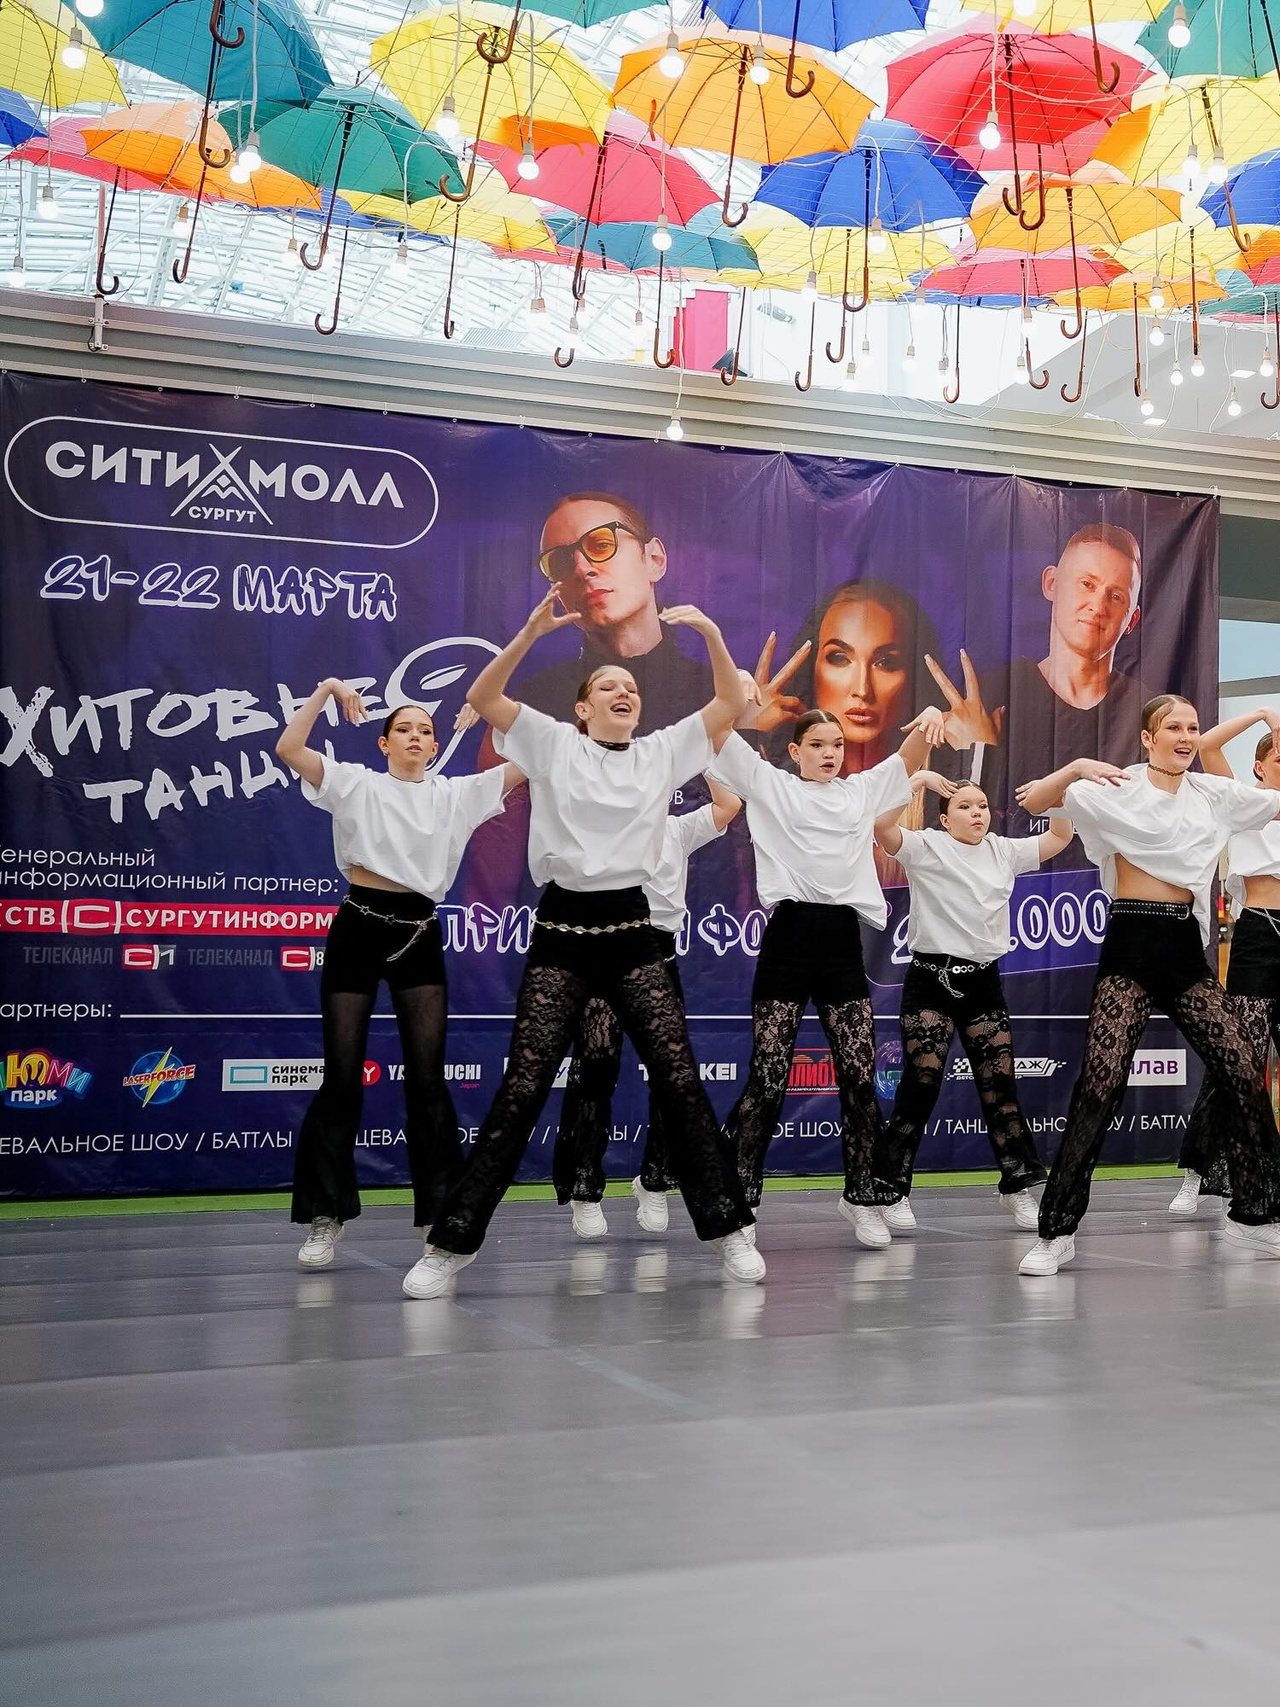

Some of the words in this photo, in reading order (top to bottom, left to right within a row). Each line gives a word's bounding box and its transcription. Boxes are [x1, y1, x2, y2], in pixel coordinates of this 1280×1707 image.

[45, 440, 201, 488] СИТИ
[248, 460, 405, 509] МОЛЛ
[188, 506, 257, 524] СУРГУТ
[40, 554, 221, 610] 21-22
[232, 563, 399, 622] МАРТА
[234, 876, 339, 895] партнер:
[5, 906, 55, 925] СТВ
[126, 908, 337, 929] СУРГУТИНФОРМ
[22, 946, 114, 966] ТЕЛЕКАНАЛ
[187, 948, 273, 967] ТЕЛЕКАНАЛ
[271, 1075, 309, 1086] парк
[388, 1064, 482, 1081] YAUCHI
[10, 1089, 57, 1105] парк
[131, 1133, 189, 1151] ШОУ
[212, 1131, 292, 1150] БАТТЛЫ
[1141, 1114, 1191, 1130] БАТТЛ
